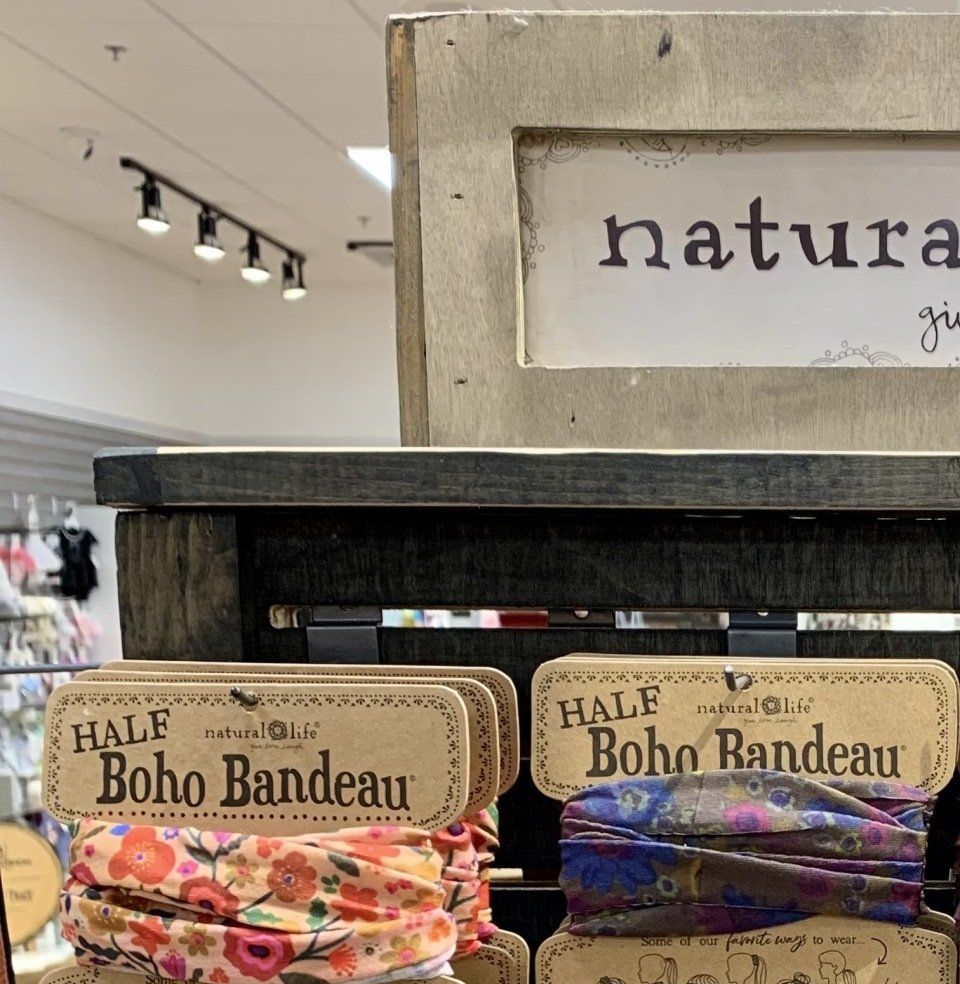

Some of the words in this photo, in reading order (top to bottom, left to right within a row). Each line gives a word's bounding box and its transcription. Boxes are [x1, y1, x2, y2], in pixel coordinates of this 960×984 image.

[557, 685, 661, 729] HALF
[698, 696, 759, 715] natural
[72, 709, 170, 753] HALF
[205, 721, 268, 740] natural
[586, 727, 698, 778] Boho
[96, 750, 206, 807] Boho
[641, 935, 675, 948] Some
[680, 936, 691, 947] of
[699, 937, 718, 947] our
[725, 933, 773, 953] favorite
[774, 933, 807, 952] ways
[813, 935, 823, 946] to
